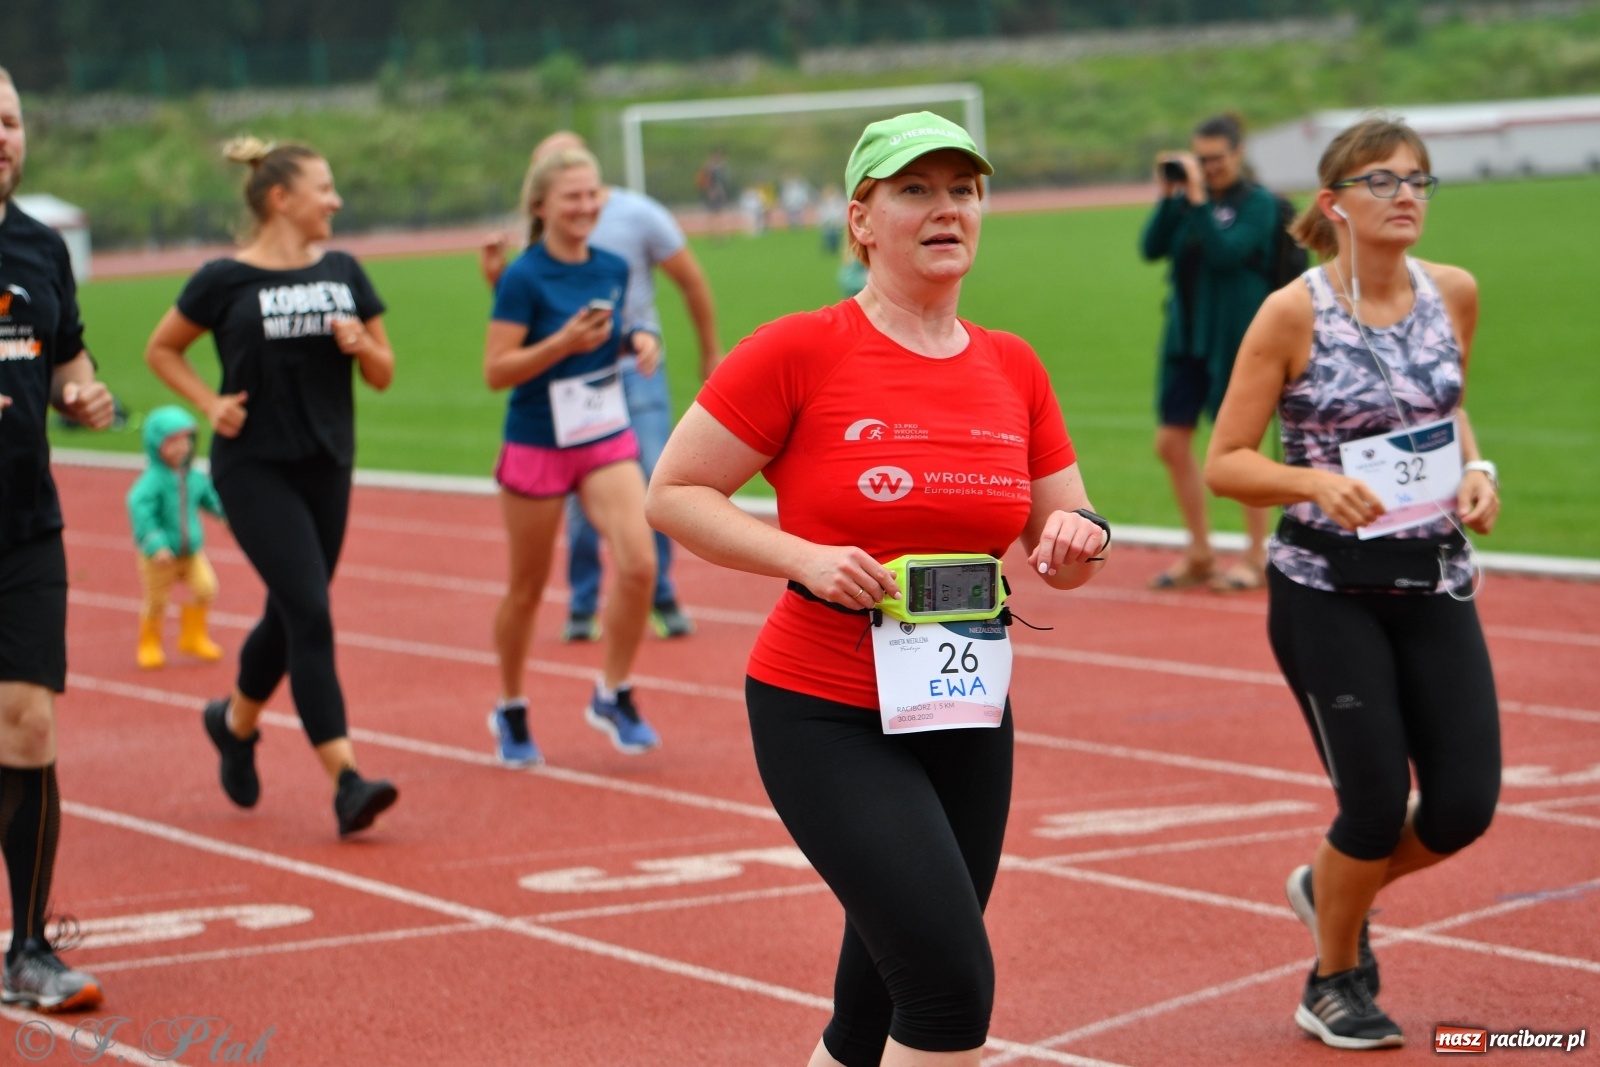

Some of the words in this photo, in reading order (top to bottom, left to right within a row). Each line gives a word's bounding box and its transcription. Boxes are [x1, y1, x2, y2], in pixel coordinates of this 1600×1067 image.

[1395, 457, 1426, 485] 32
[924, 472, 1012, 487] WROCŁAW
[924, 486, 983, 496] Europejska
[986, 488, 1016, 499] Stolica
[938, 641, 979, 674] 26
[929, 676, 987, 697] EWA
[896, 704, 931, 713] RACIBÓRZ
[897, 713, 934, 723] 30.08.2020
